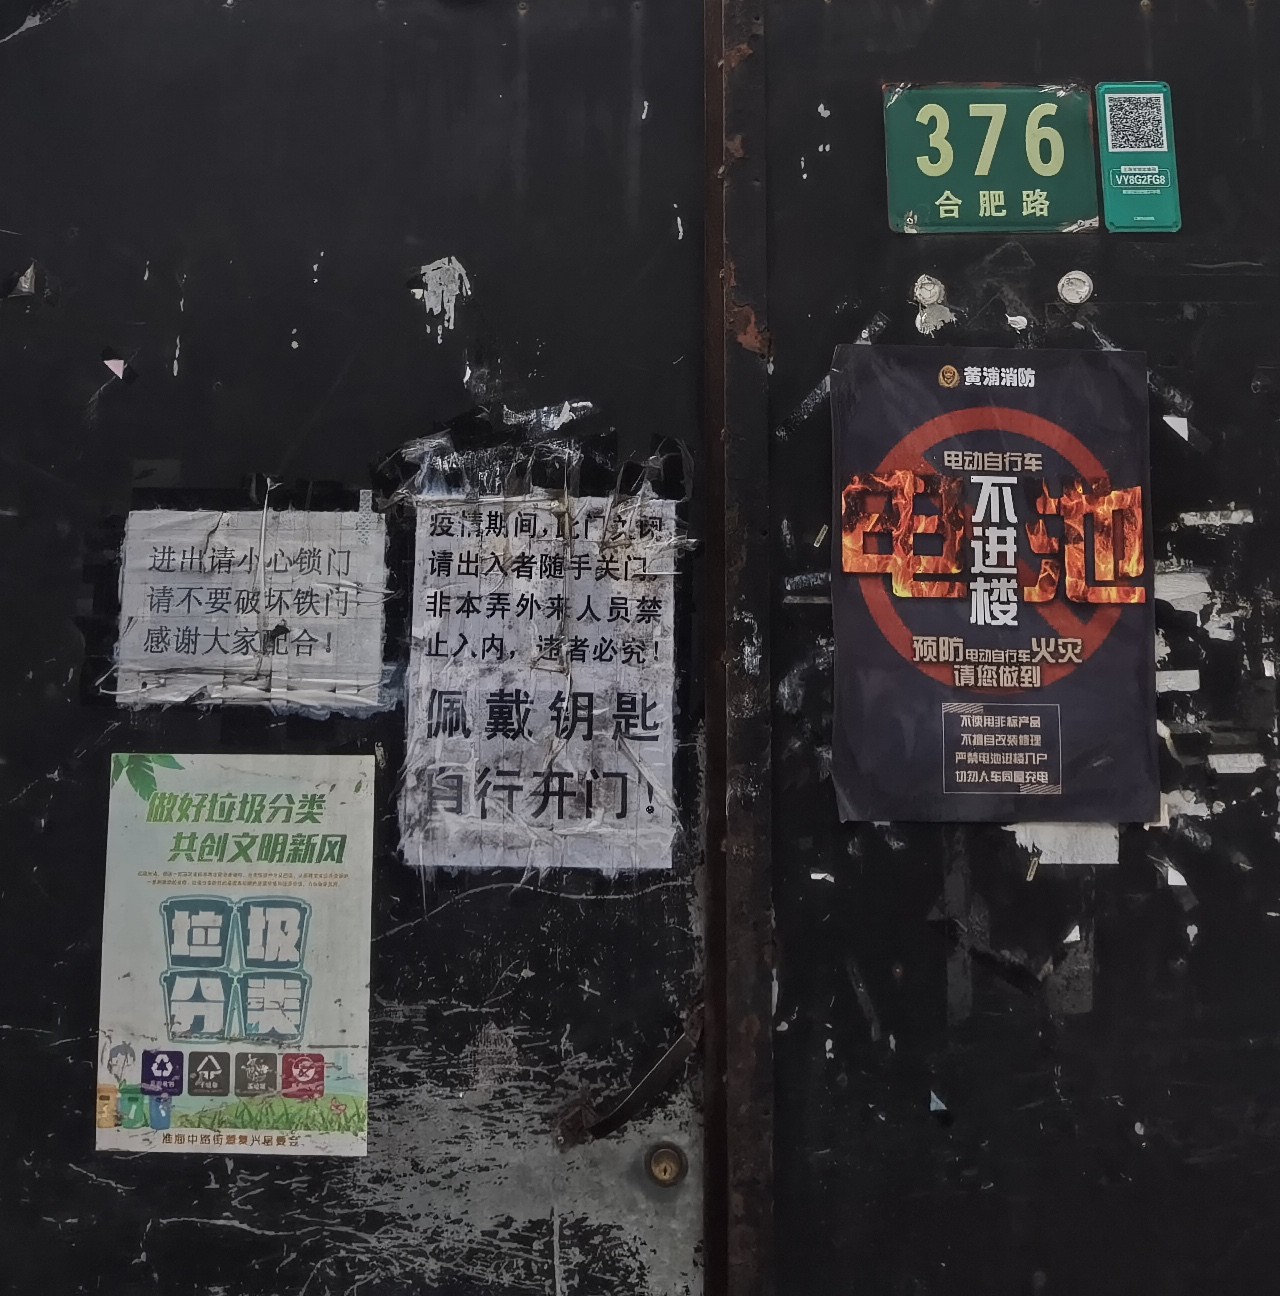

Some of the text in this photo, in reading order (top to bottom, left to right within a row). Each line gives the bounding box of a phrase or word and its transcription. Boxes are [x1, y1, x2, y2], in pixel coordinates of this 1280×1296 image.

[916, 103, 1065, 177] 376
[1115, 174, 1166, 185] VY8G2FG8
[934, 189, 1050, 218] 合肥路
[963, 366, 1036, 387] 黄浦消防
[943, 451, 1042, 472] 电动自行车
[148, 545, 352, 576] 进出请小心锁门
[969, 475, 1019, 626] 不进楼
[146, 585, 350, 617] 请不要破坏铁门
[425, 590, 663, 624] 非本弄外来人员禁
[912, 636, 1083, 664] 预防电动自行车火灾
[953, 665, 1041, 688] 请您做到
[426, 688, 660, 742] 佩戴钥匙
[960, 715, 1041, 728] 不使用非标产品
[955, 752, 1048, 765] 严禁电池进楼入户
[146, 792, 326, 824] 做好垃圾分类
[167, 831, 348, 864] 共创文明新风
